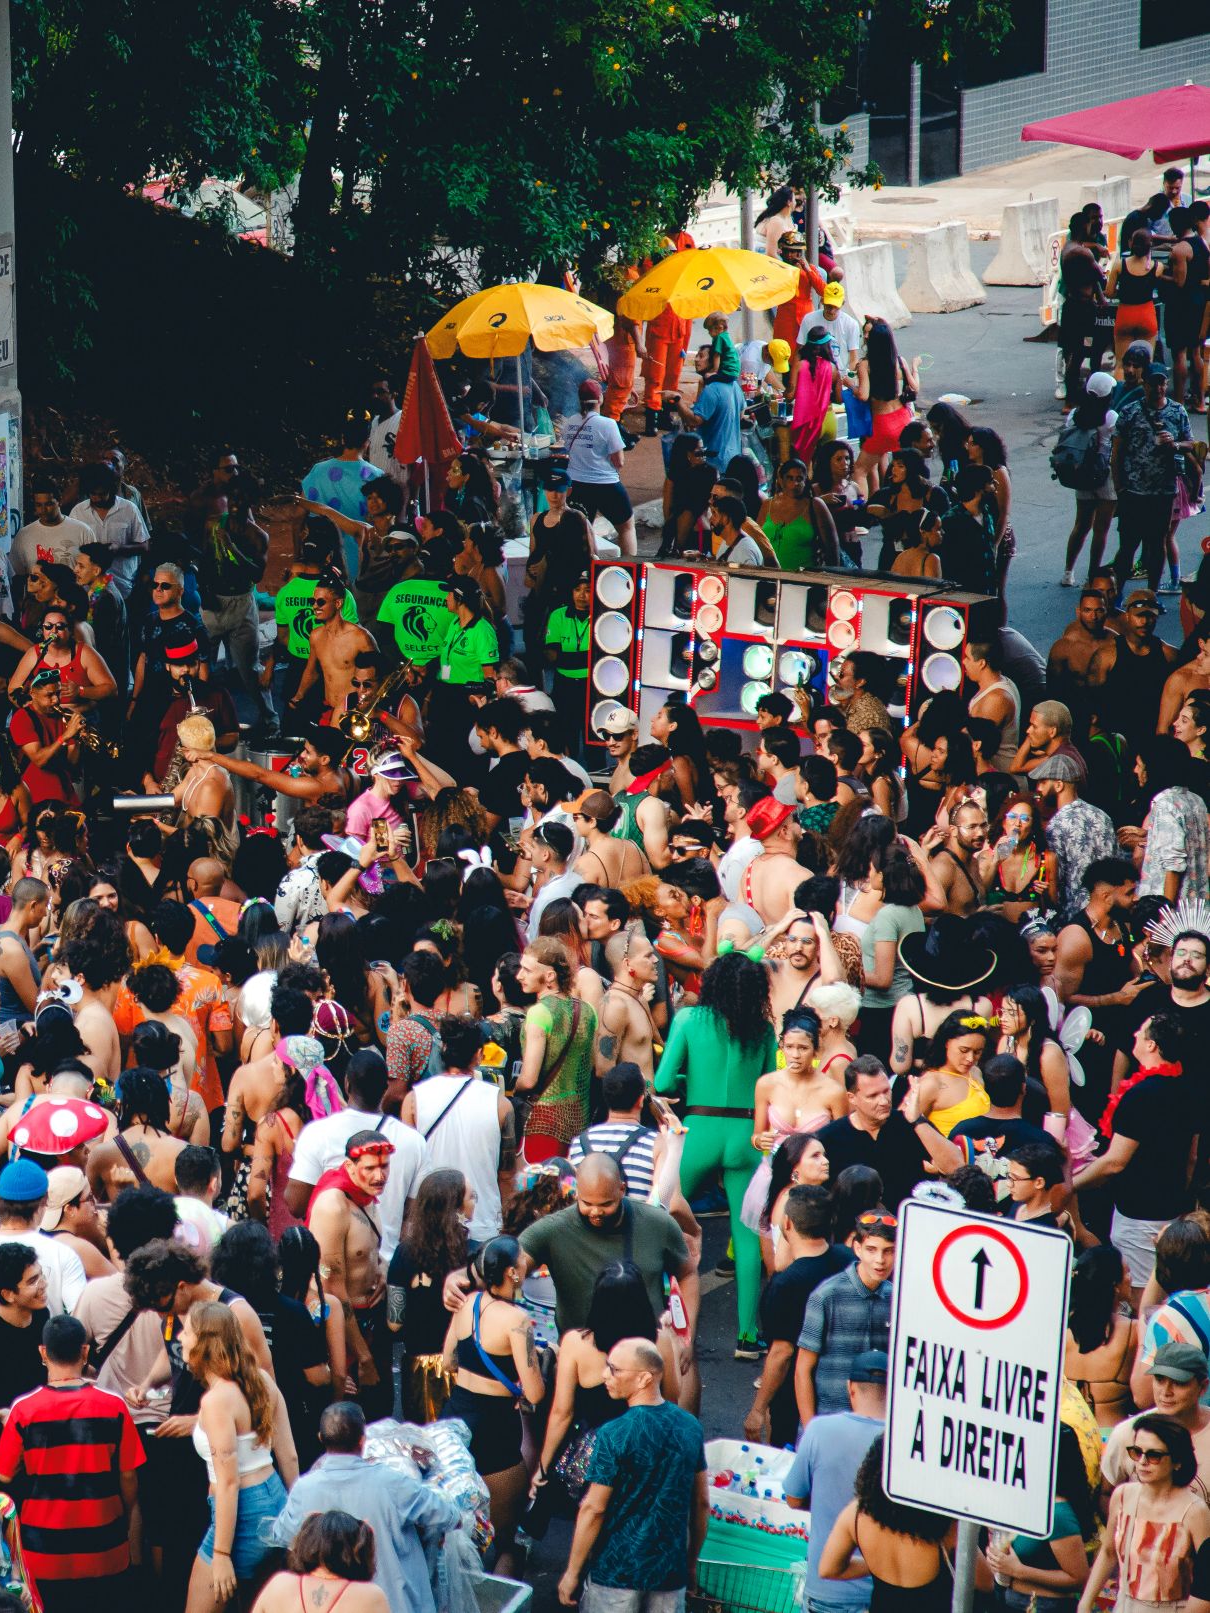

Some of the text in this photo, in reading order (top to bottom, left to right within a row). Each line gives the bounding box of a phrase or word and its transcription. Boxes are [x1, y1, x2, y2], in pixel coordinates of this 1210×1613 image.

[295, 646, 311, 655] SEL
[404, 643, 439, 652] SELECT
[903, 1335, 1049, 1424] FAIXA LIVRE
[910, 1395, 1027, 1490] À DIREITA
